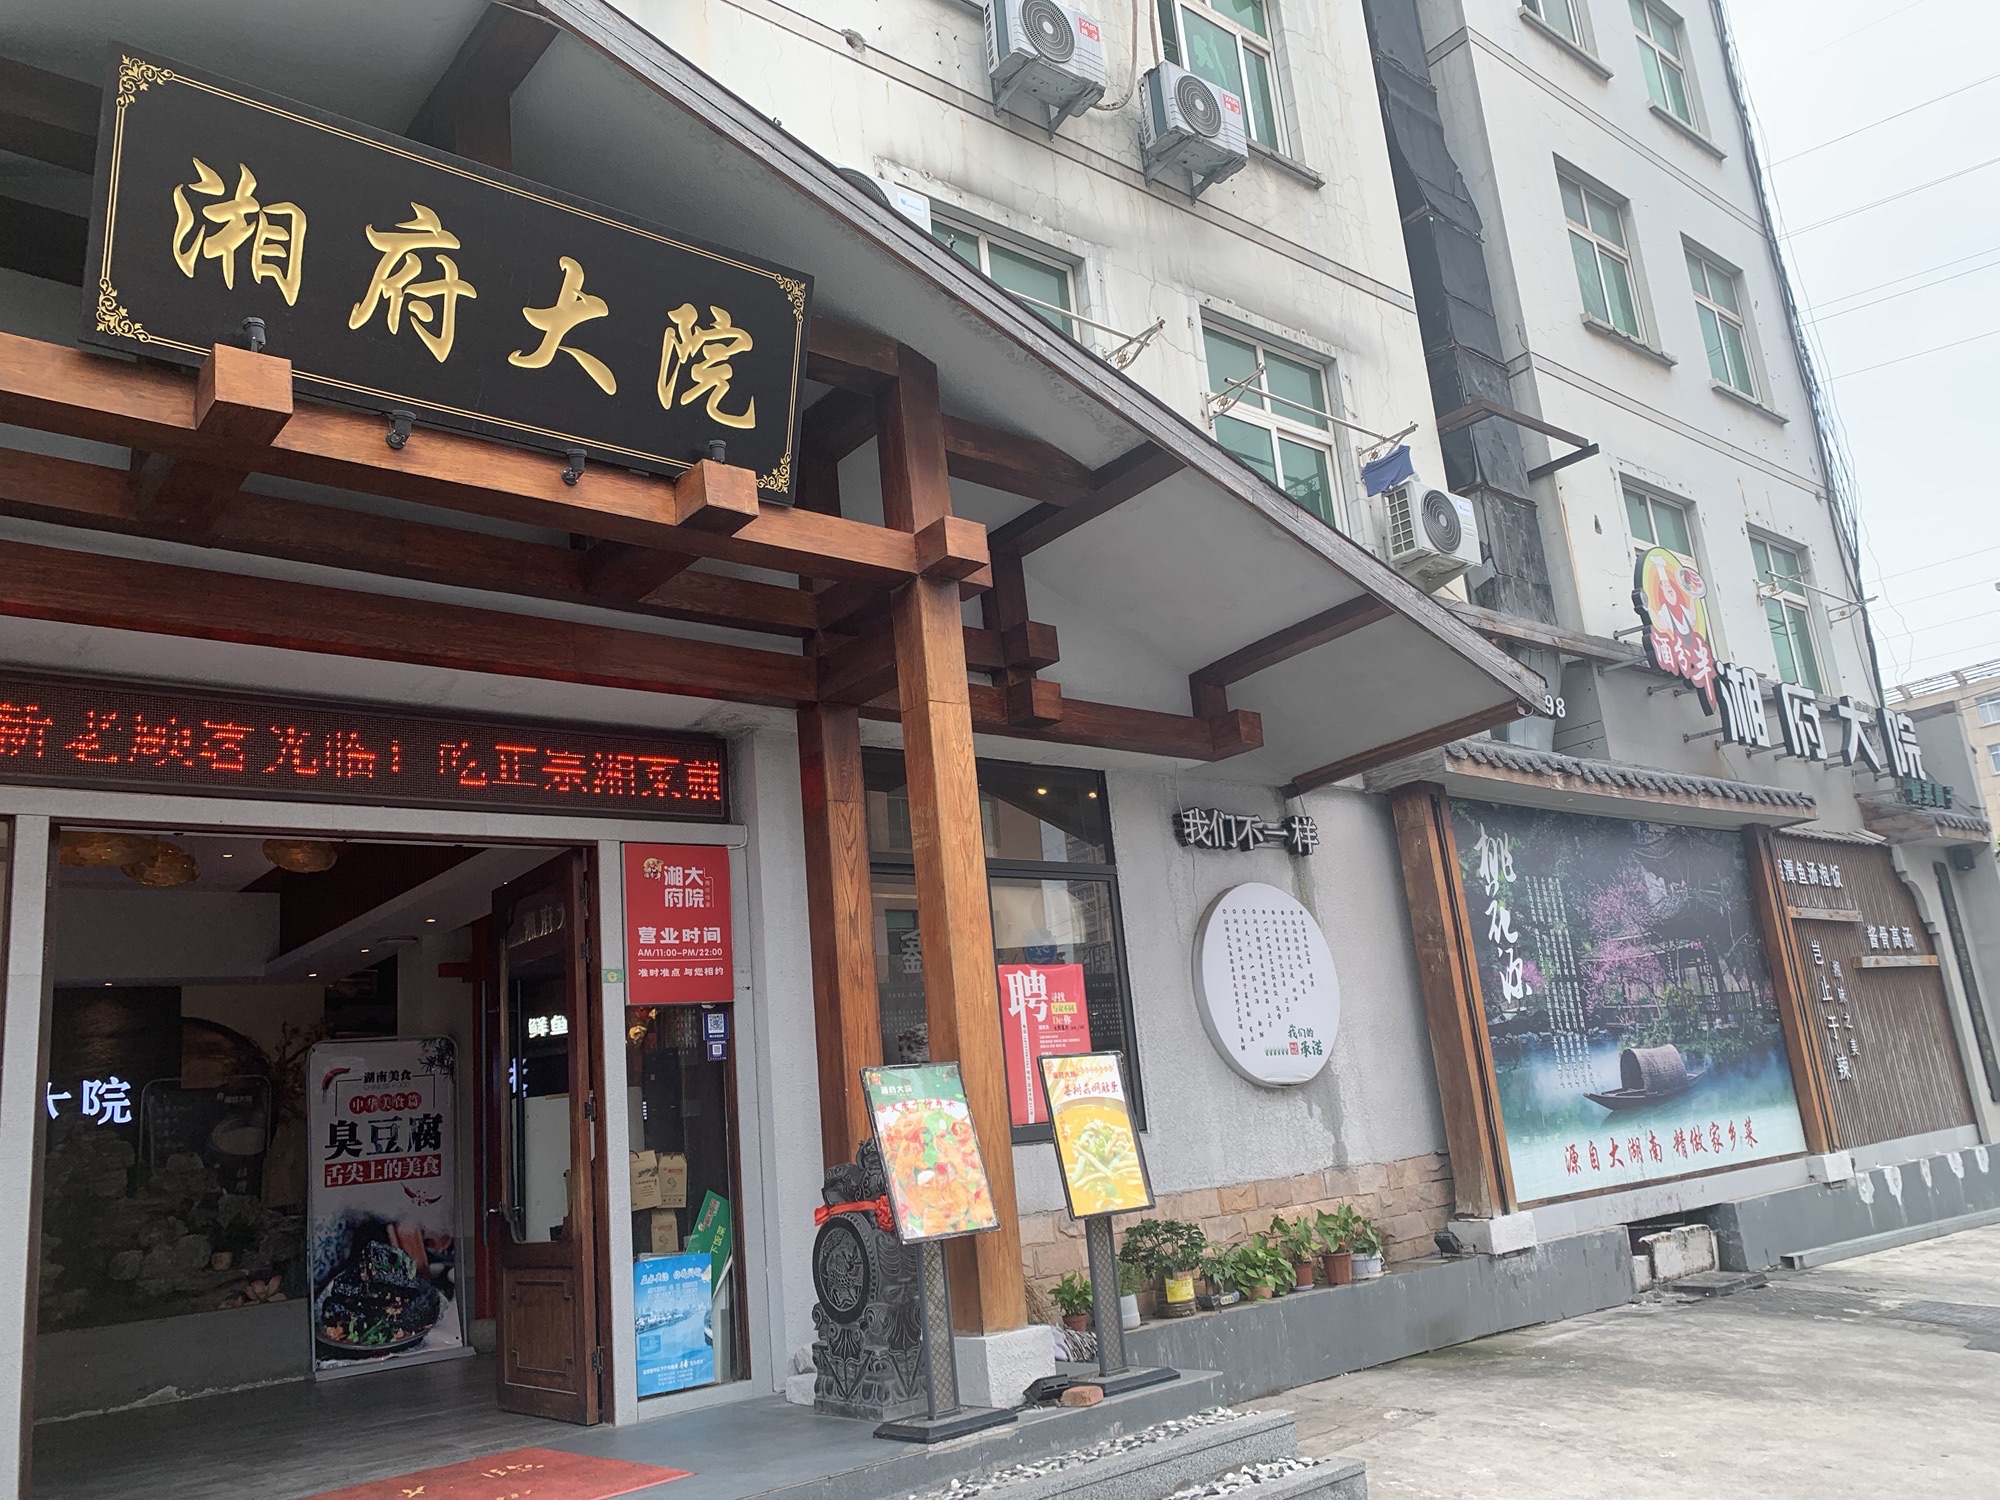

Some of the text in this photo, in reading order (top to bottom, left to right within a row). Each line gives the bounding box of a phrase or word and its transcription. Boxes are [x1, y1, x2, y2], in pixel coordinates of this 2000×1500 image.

[172, 157, 757, 430] 湘府大院
[1717, 662, 1926, 780] 湘府大院
[1181, 808, 1319, 854] 我们不一样
[638, 926, 721, 944] 营业时间
[638, 967, 724, 978] 准时准点 与您相约
[1005, 969, 1049, 1022] 聘
[1288, 1024, 1314, 1039] 我们的
[1810, 939, 1852, 1081] 岂止于辣
[1300, 1040, 1323, 1058] 承诺
[363, 1069, 412, 1084] 湖南美食
[324, 1112, 444, 1161] 臭豆腐
[1564, 1116, 1759, 1176] 源自大湖南 精做家乡菜
[326, 1156, 441, 1186] 舌尖上的美食
